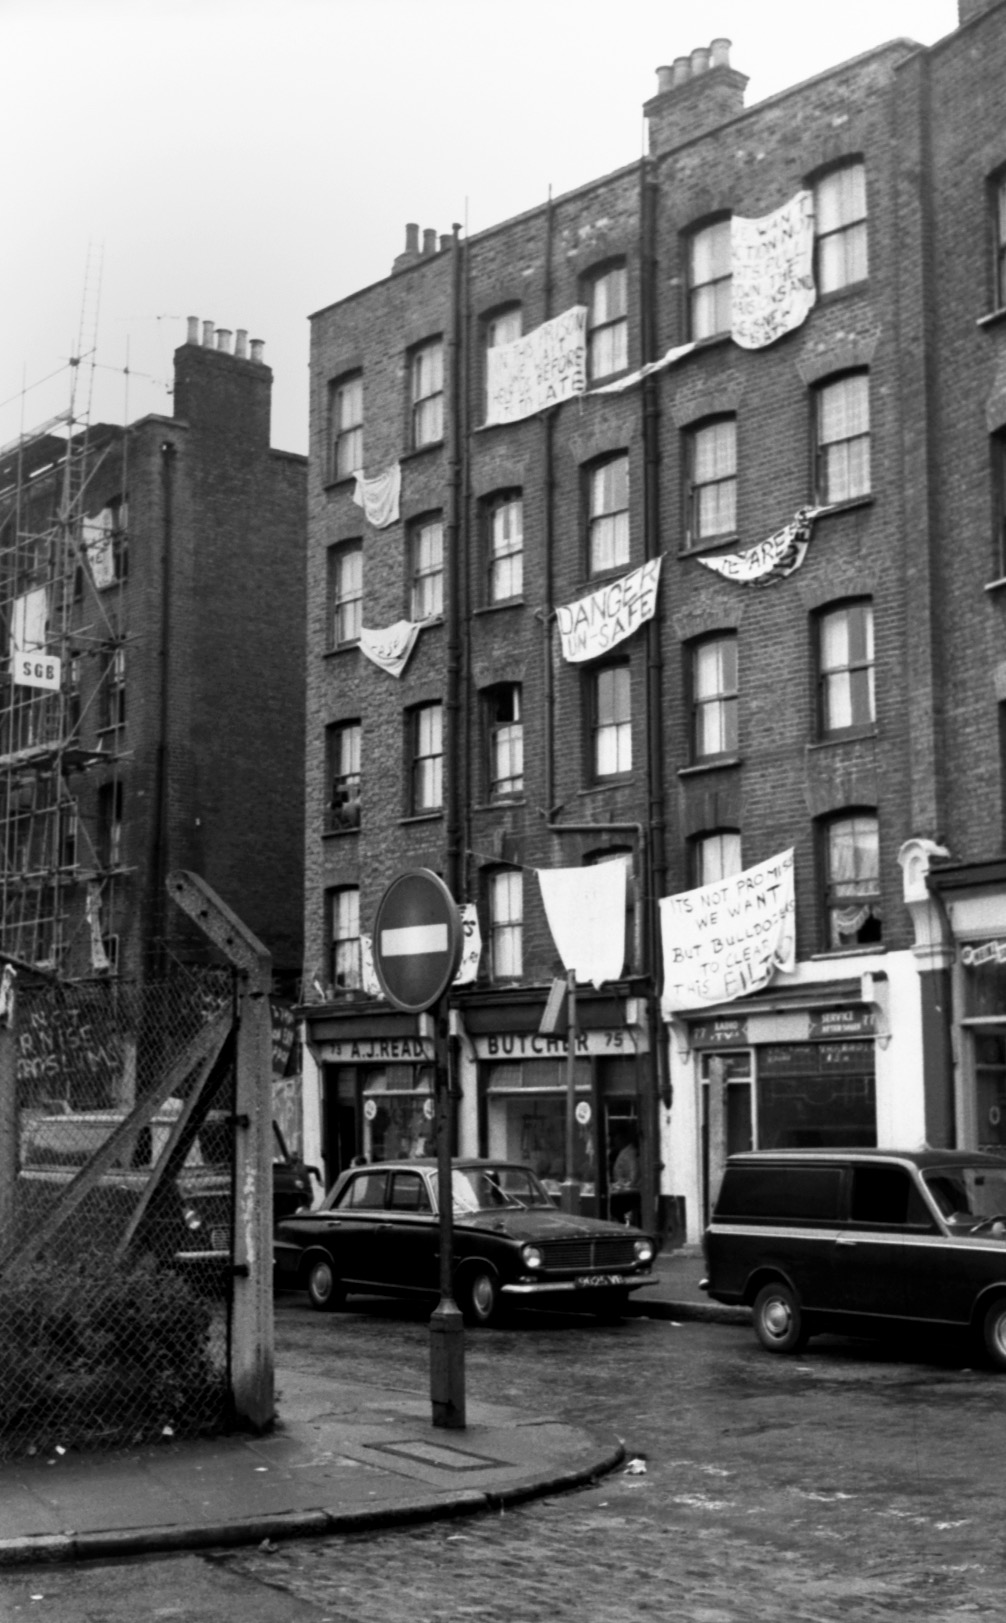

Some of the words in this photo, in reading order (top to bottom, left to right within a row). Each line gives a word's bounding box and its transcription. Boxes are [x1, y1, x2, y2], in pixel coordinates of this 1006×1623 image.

[537, 370, 585, 406] LATE
[558, 558, 658, 636] DANGER
[23, 661, 54, 680] SGB
[696, 911, 718, 931] WE
[728, 884, 782, 918] WANT
[700, 887, 729, 908] NOT
[672, 944, 703, 963] BUT
[700, 962, 719, 977] TO
[604, 1032, 624, 1048] 75
